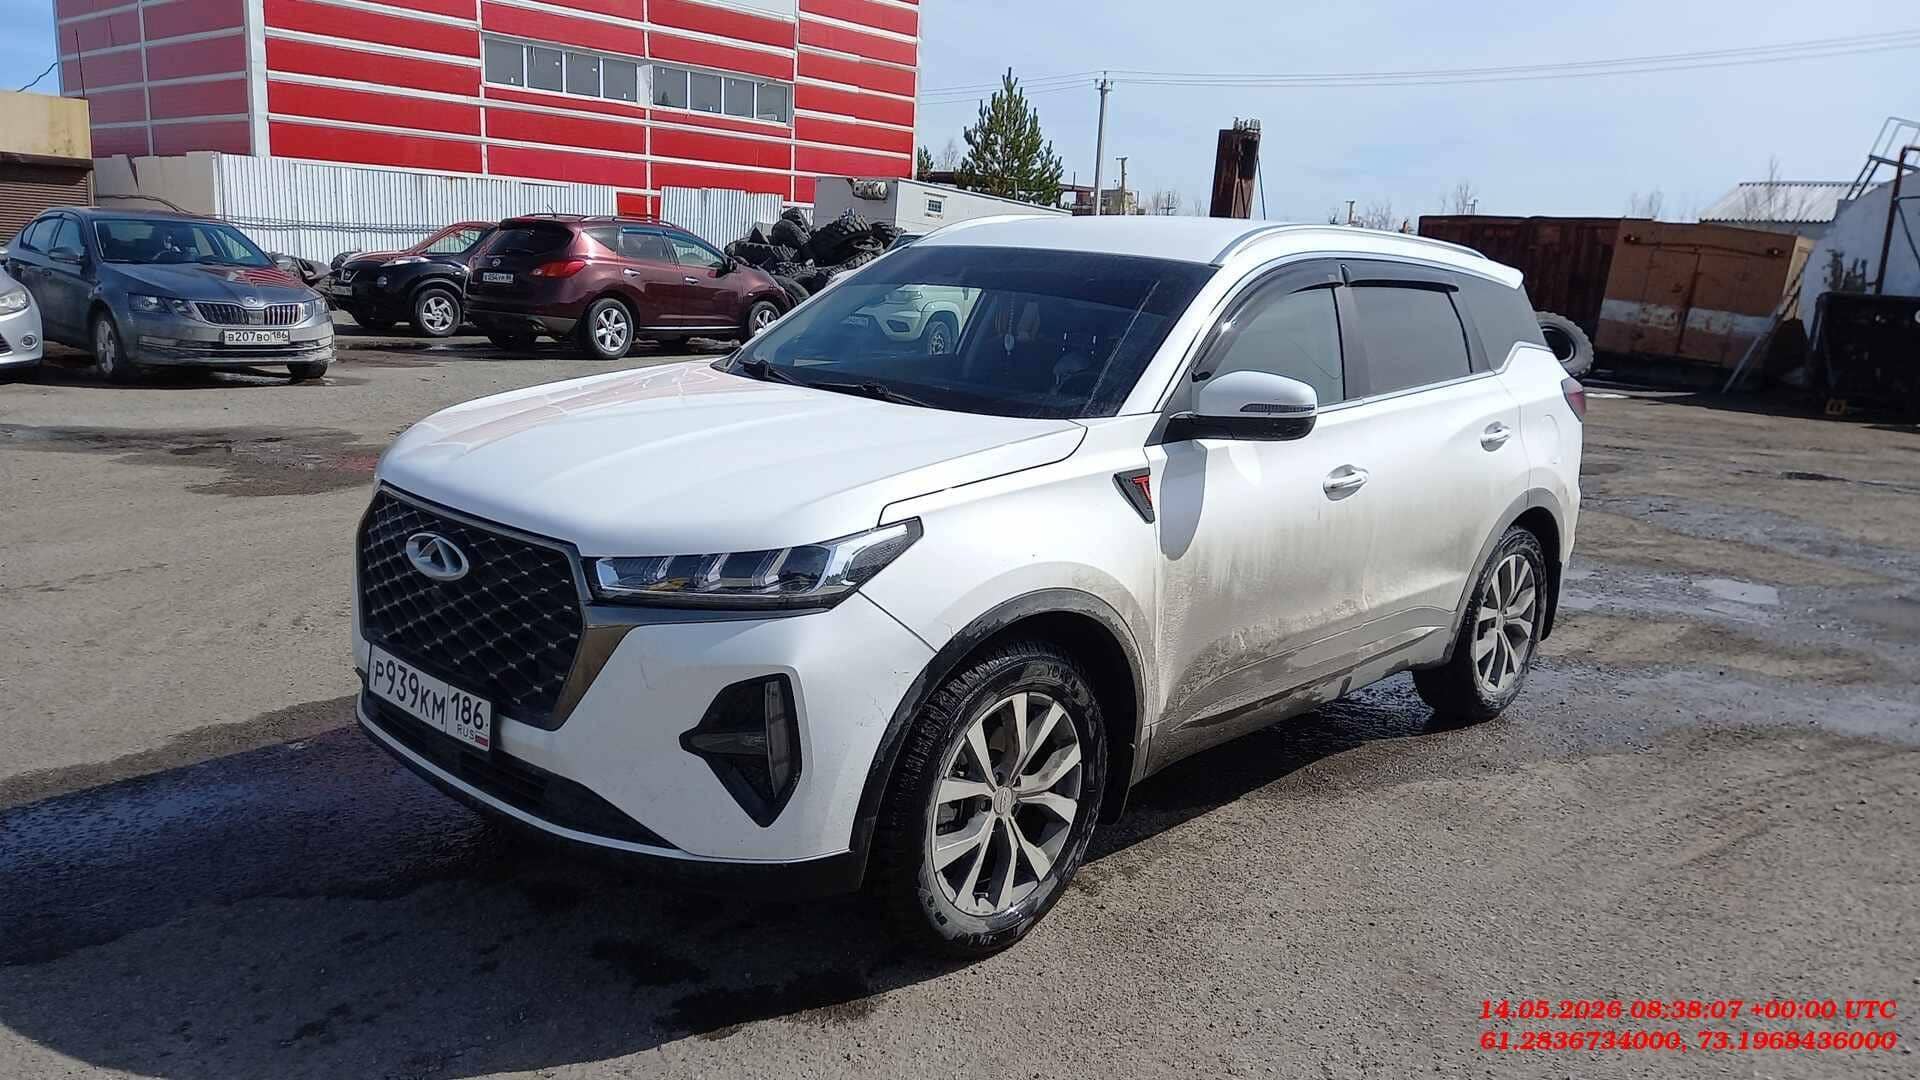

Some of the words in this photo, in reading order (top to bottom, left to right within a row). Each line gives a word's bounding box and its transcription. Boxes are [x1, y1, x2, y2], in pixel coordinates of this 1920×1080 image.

[374, 659, 446, 725] Р939КМ
[450, 691, 485, 730] 186
[457, 723, 476, 740] RUS
